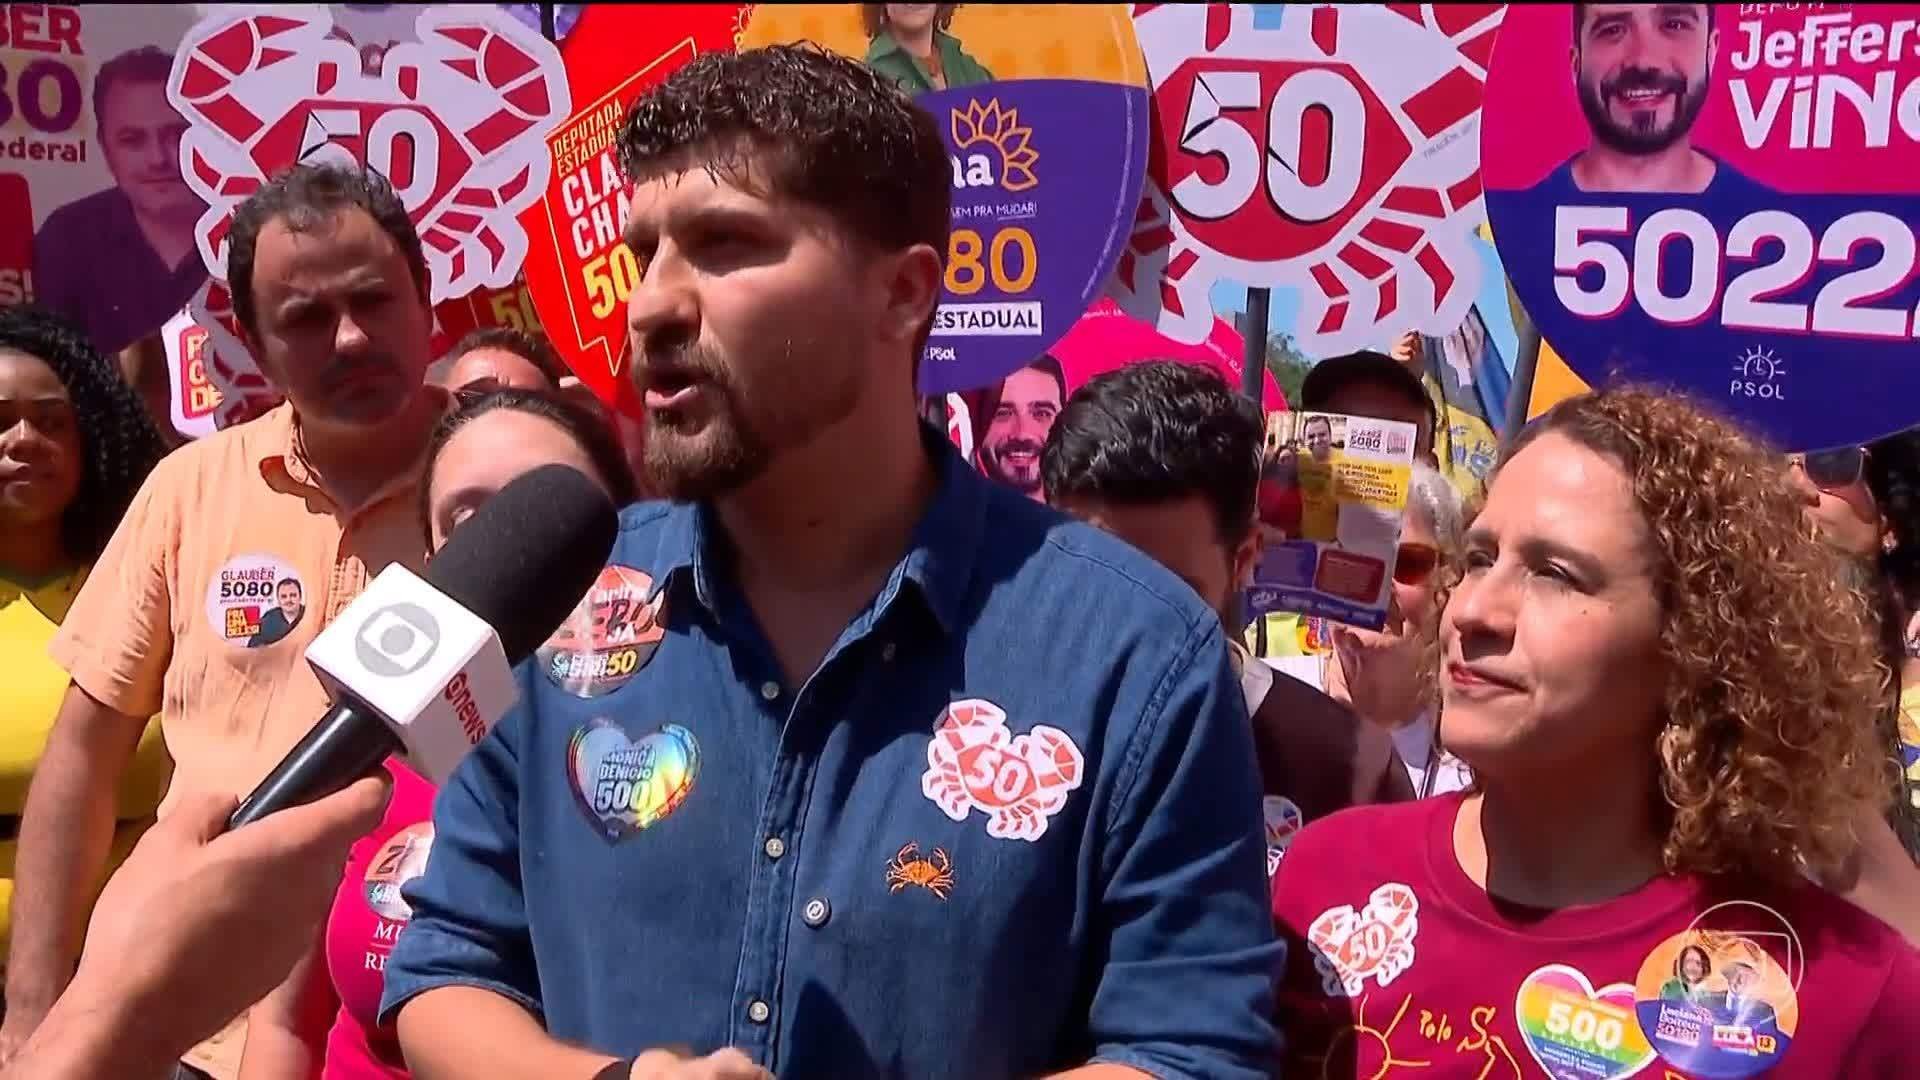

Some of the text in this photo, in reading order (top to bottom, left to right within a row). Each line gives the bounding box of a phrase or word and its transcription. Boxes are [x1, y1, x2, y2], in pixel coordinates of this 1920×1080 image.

[0, 137, 86, 163] deral
[553, 98, 624, 160] DEPUTADA
[557, 120, 622, 178] ESTADUA
[1171, 68, 1366, 222] 50
[297, 104, 440, 214] 50
[582, 243, 643, 319] 50
[1554, 205, 1920, 338] 5022
[1730, 380, 1785, 400] PSOL
[220, 581, 274, 598] 5080
[452, 687, 486, 745] news
[595, 780, 652, 814] 500
[963, 749, 1028, 802] 50
[1348, 923, 1387, 974] 50
[1545, 1002, 1624, 1050] 500
[1759, 1035, 1773, 1049] 13
